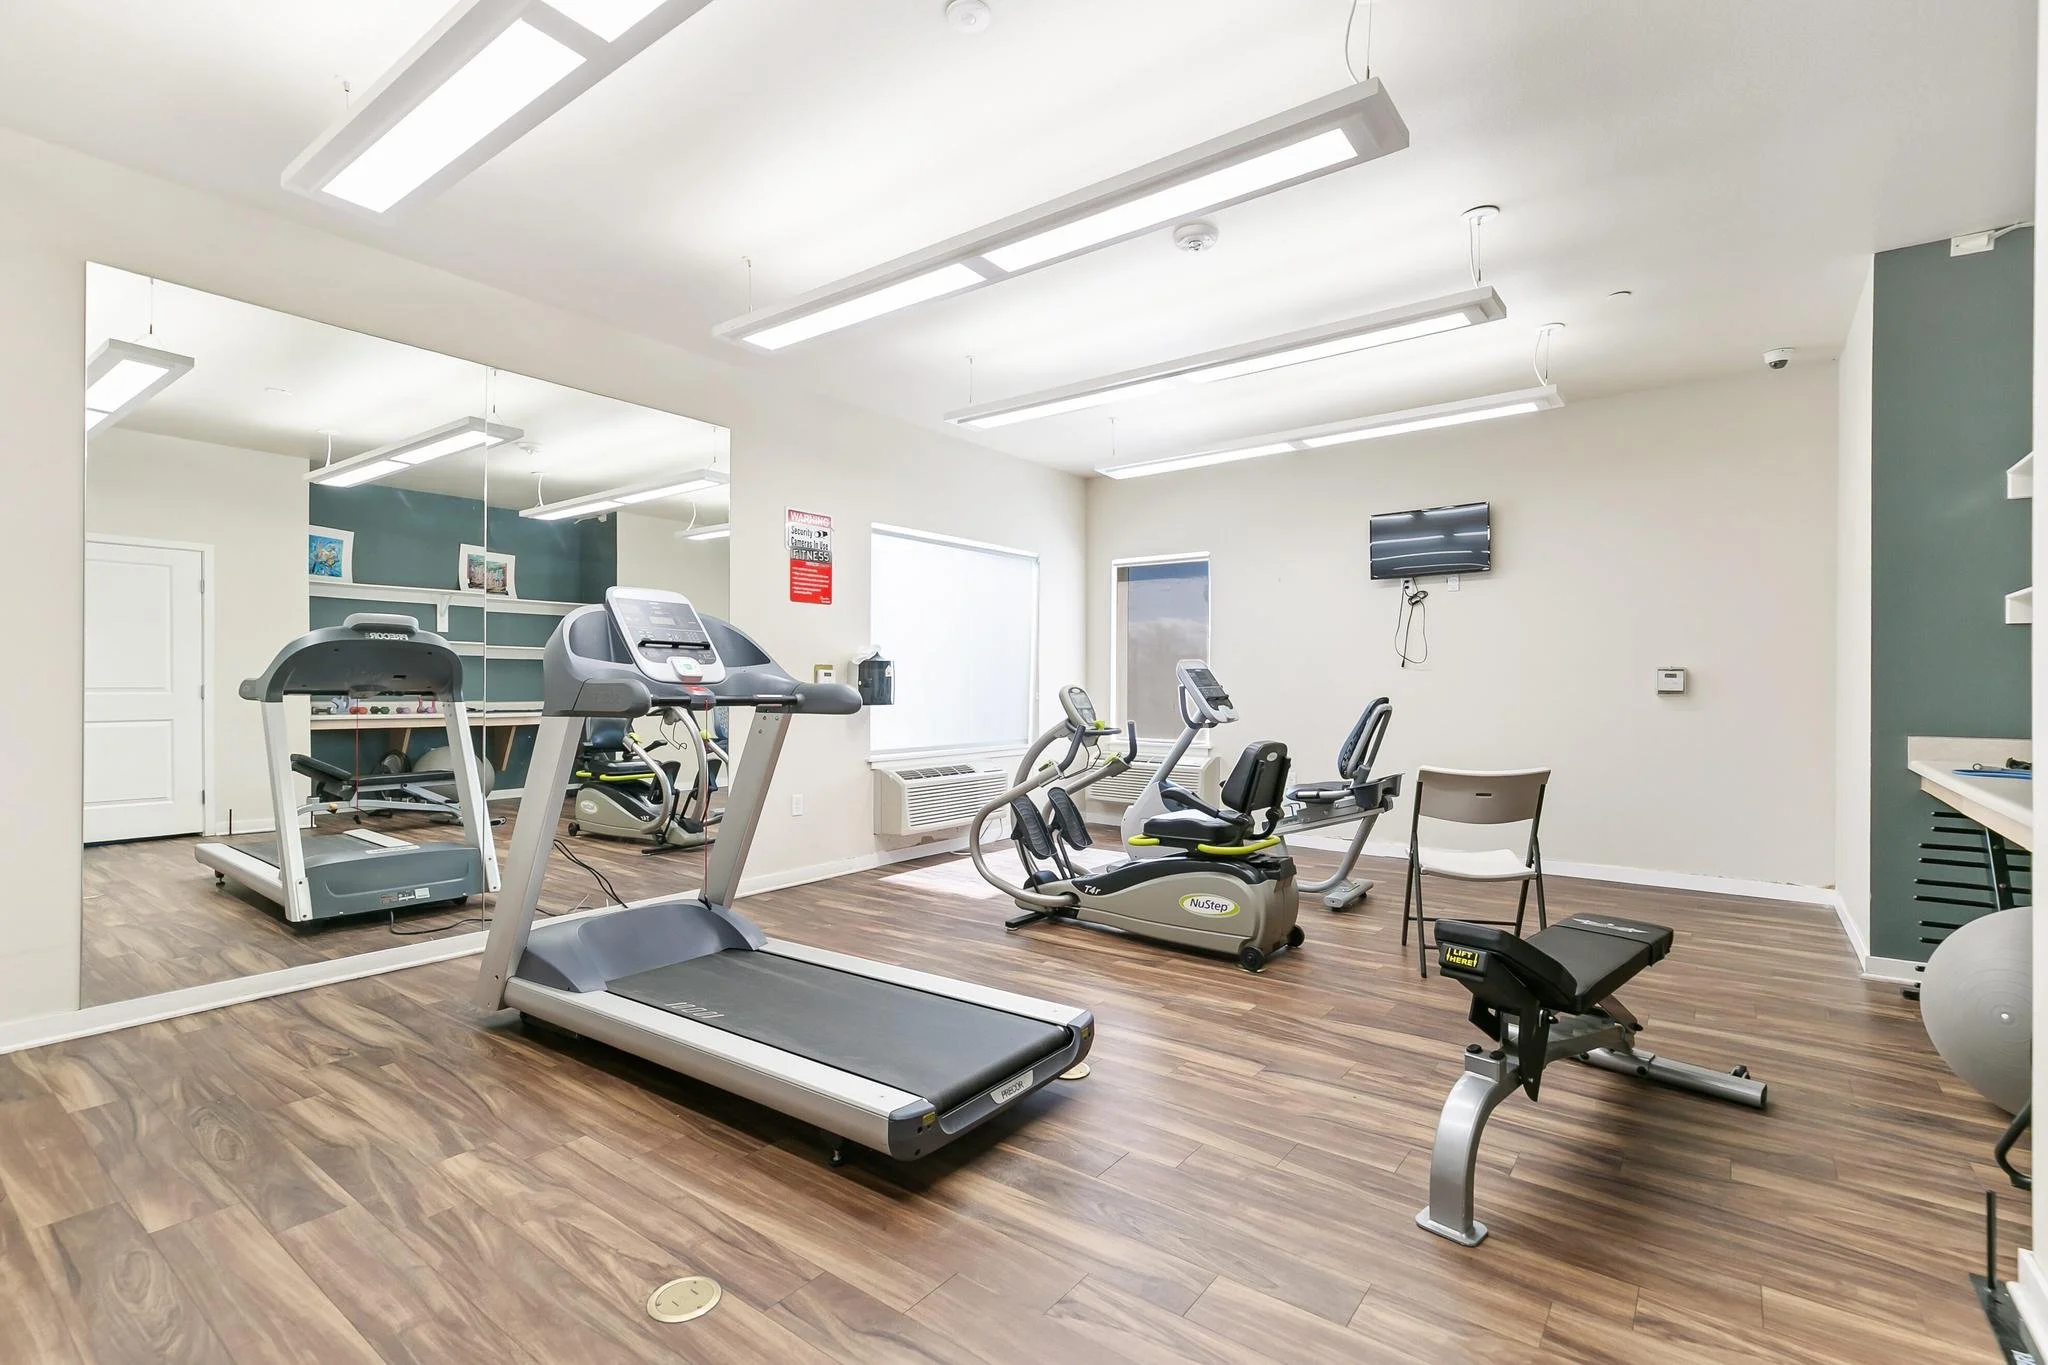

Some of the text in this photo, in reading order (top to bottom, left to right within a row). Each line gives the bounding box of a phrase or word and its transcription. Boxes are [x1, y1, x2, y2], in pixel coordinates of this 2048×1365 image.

[791, 526, 813, 538] Security
[793, 549, 829, 562] FITNESS
[1084, 885, 1101, 895] T4r
[1190, 898, 1228, 912] NuStep
[1453, 948, 1473, 958] LIFT
[1449, 955, 1473, 967] HERE
[1001, 1080, 1025, 1100] PRECOR
